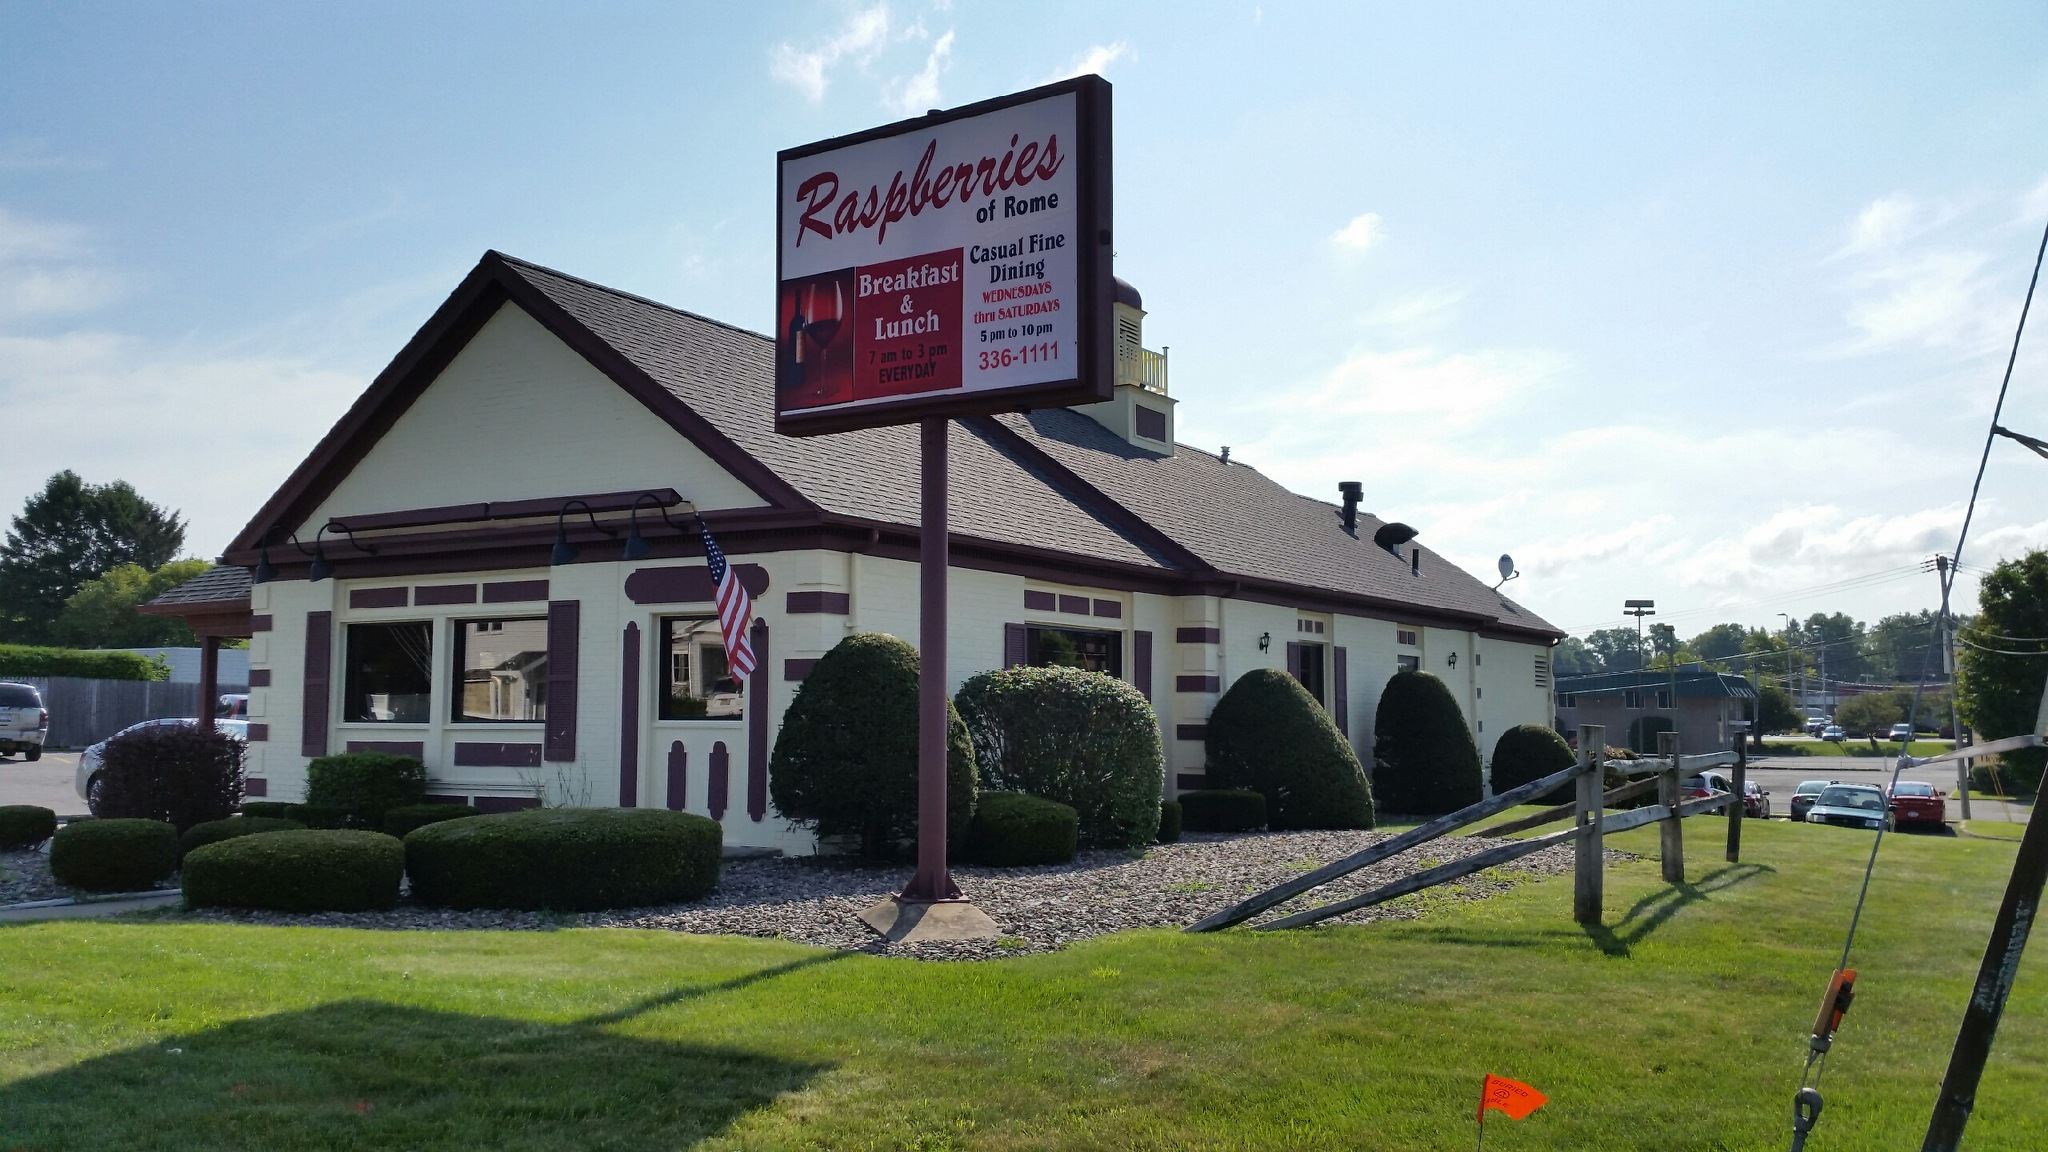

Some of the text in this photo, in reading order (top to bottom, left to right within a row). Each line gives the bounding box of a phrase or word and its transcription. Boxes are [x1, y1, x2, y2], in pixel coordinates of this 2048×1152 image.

[796, 133, 1065, 248] Raspberries
[976, 192, 1059, 224] of Rome
[970, 233, 1065, 264] Casual Fine
[859, 261, 959, 298] Breakfast
[990, 259, 1045, 283] Dining
[900, 294, 914, 314] &
[982, 281, 1052, 304] WEDNESDAYS
[875, 309, 940, 340] Lunch
[974, 299, 1060, 325] thru SATURDAYS
[980, 323, 1053, 343] 5 pm to 10 pm
[869, 343, 948, 366] 7 am to 3 pm
[979, 340, 1058, 370] 336-1111
[1491, 1079, 1529, 1097] BURIED
